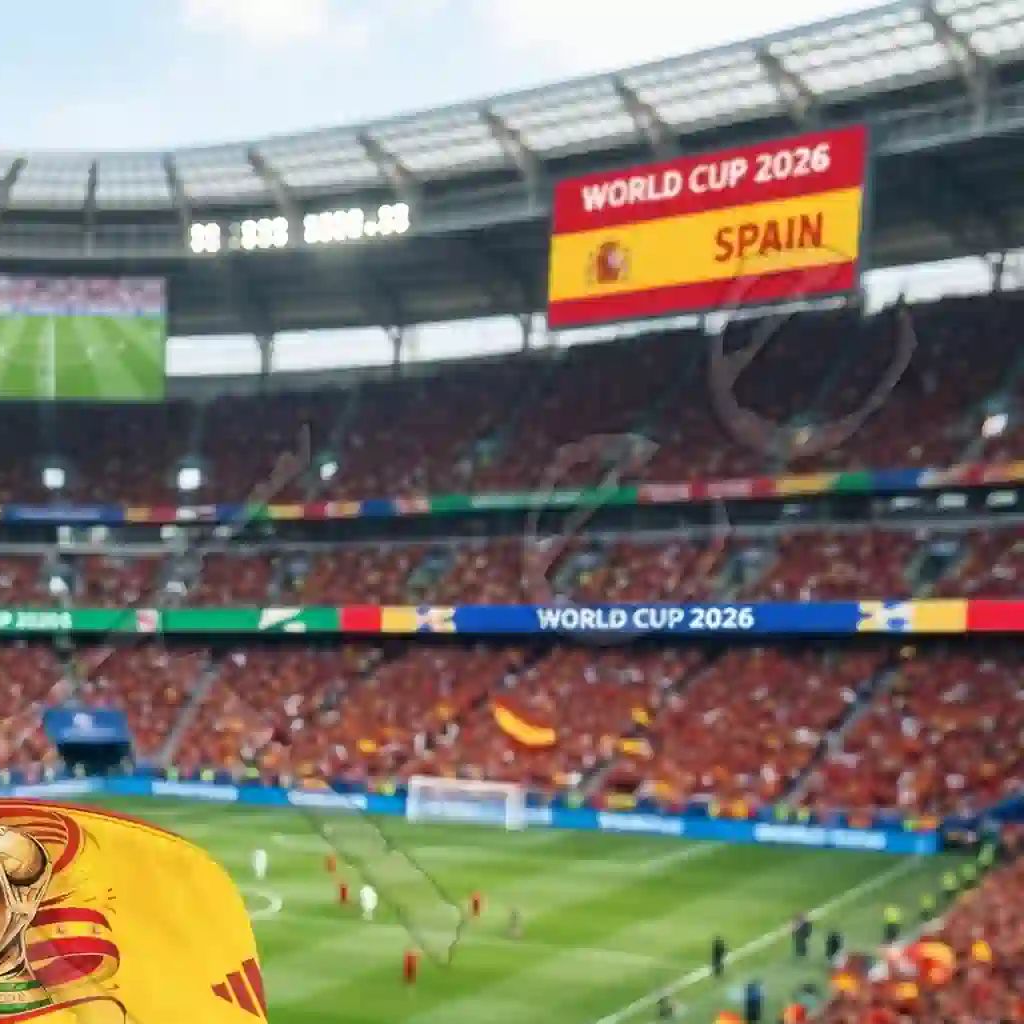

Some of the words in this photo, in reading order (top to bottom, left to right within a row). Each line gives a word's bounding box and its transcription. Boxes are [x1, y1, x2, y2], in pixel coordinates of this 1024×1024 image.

[581, 170, 682, 212] WORLD
[688, 158, 748, 193] CUP
[754, 143, 831, 184] 2026
[714, 212, 824, 263] SPAIN
[536, 607, 627, 630] WORLD
[632, 607, 685, 630] CUP
[688, 607, 755, 630] 2026
